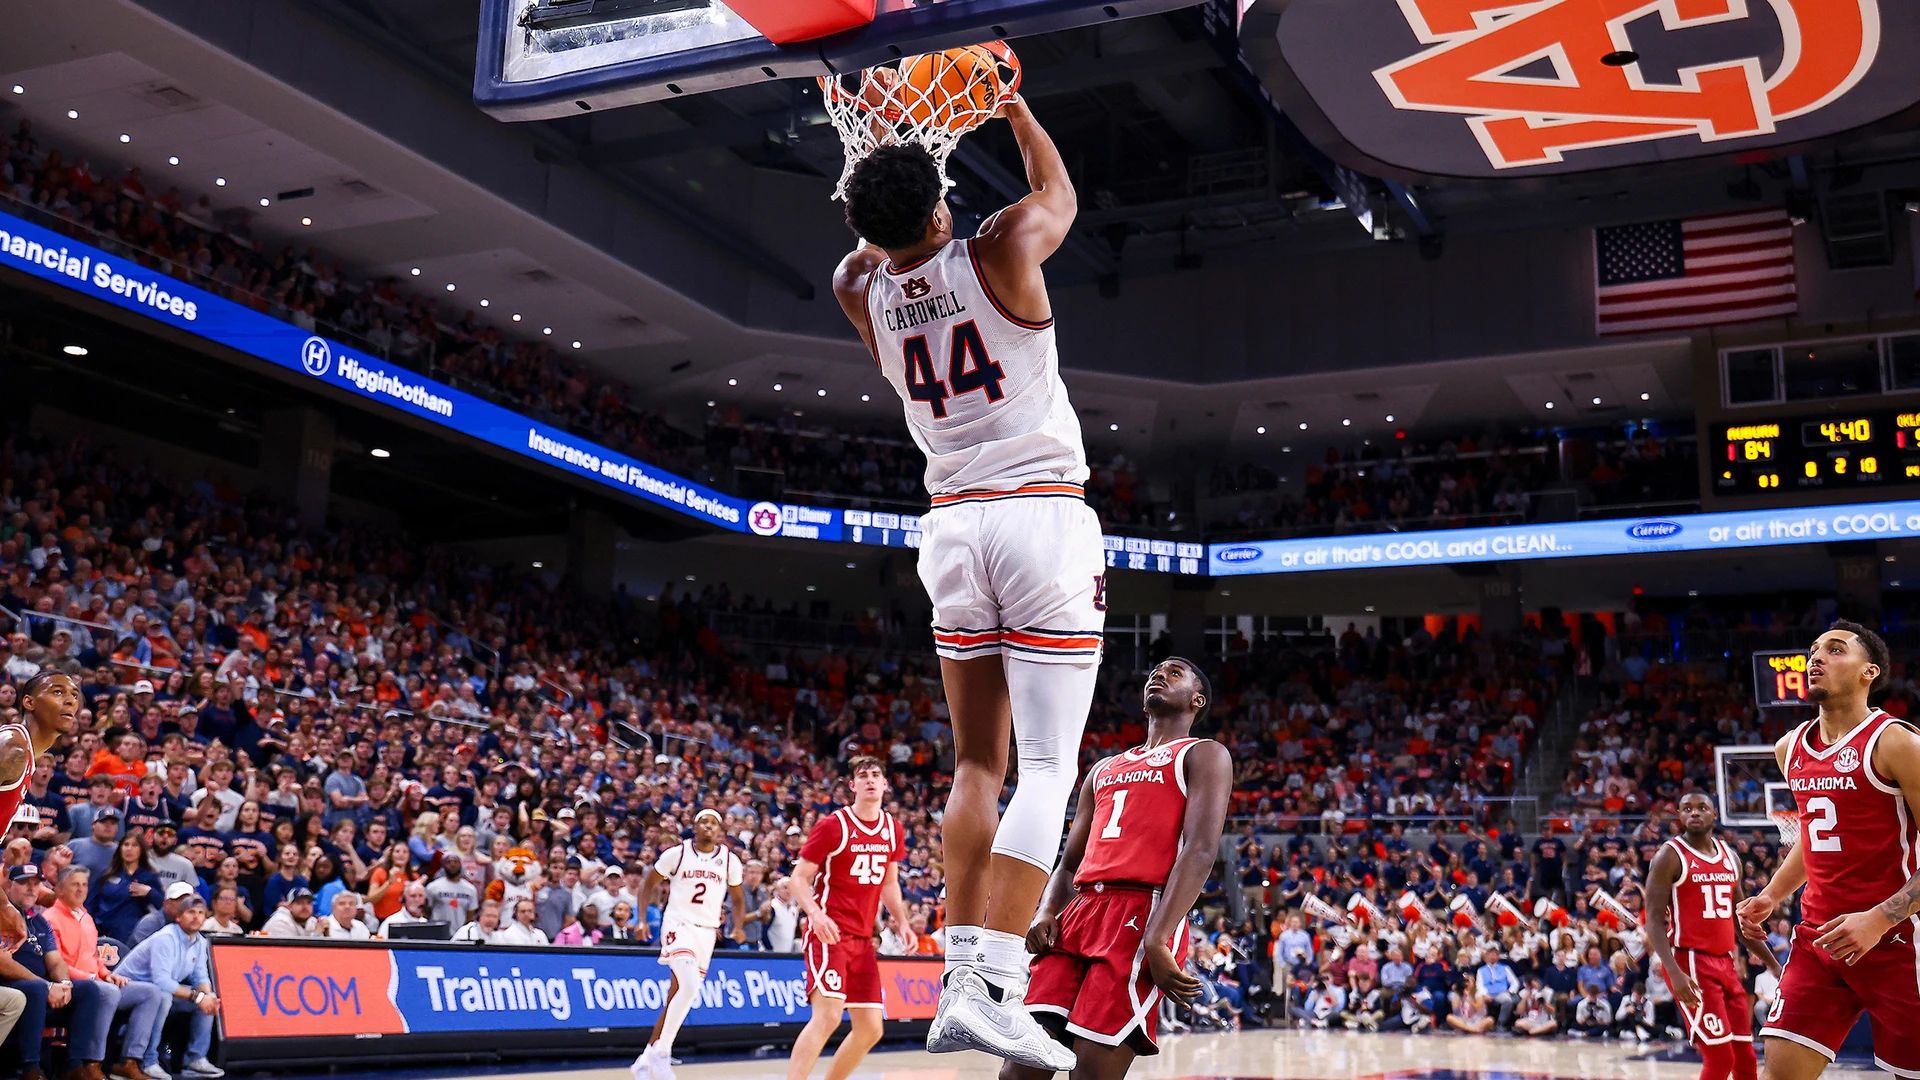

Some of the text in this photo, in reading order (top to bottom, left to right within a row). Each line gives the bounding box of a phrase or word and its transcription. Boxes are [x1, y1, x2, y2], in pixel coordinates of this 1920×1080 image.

[93, 262, 197, 321] Services
[885, 291, 966, 332] CARDWELL
[903, 319, 1006, 419] 44
[338, 355, 453, 417] Higginbotham
[1727, 424, 1780, 440] AUBURN
[1820, 419, 1871, 442] 4:40
[1744, 441, 1771, 460] 84
[528, 428, 740, 524] Insurance and Financial Services
[1708, 526, 1731, 542] or
[1736, 521, 1764, 541] air
[1769, 517, 1828, 539] that's
[1832, 513, 1901, 534] COOL
[1281, 553, 1299, 567] or
[1304, 549, 1328, 565] air
[1332, 544, 1382, 563] that's
[1385, 541, 1443, 560] COOL
[1447, 538, 1487, 557] and
[1768, 655, 1806, 672] 4:40
[1776, 671, 1808, 700] 19
[1096, 769, 1164, 789] OKLAHOMA
[1790, 776, 1858, 792] OKLAHOMA
[1101, 789, 1129, 839] 1
[1806, 796, 1842, 852] 2
[850, 843, 890, 853] OKLAHOMA
[681, 869, 723, 884] AUBURN
[850, 854, 888, 885] 45
[1692, 872, 1737, 883] OKLAHOMA
[691, 882, 707, 904] 2
[1701, 884, 1733, 919] 15
[243, 966, 810, 1021] VCOM Training Tomorw's Phys
